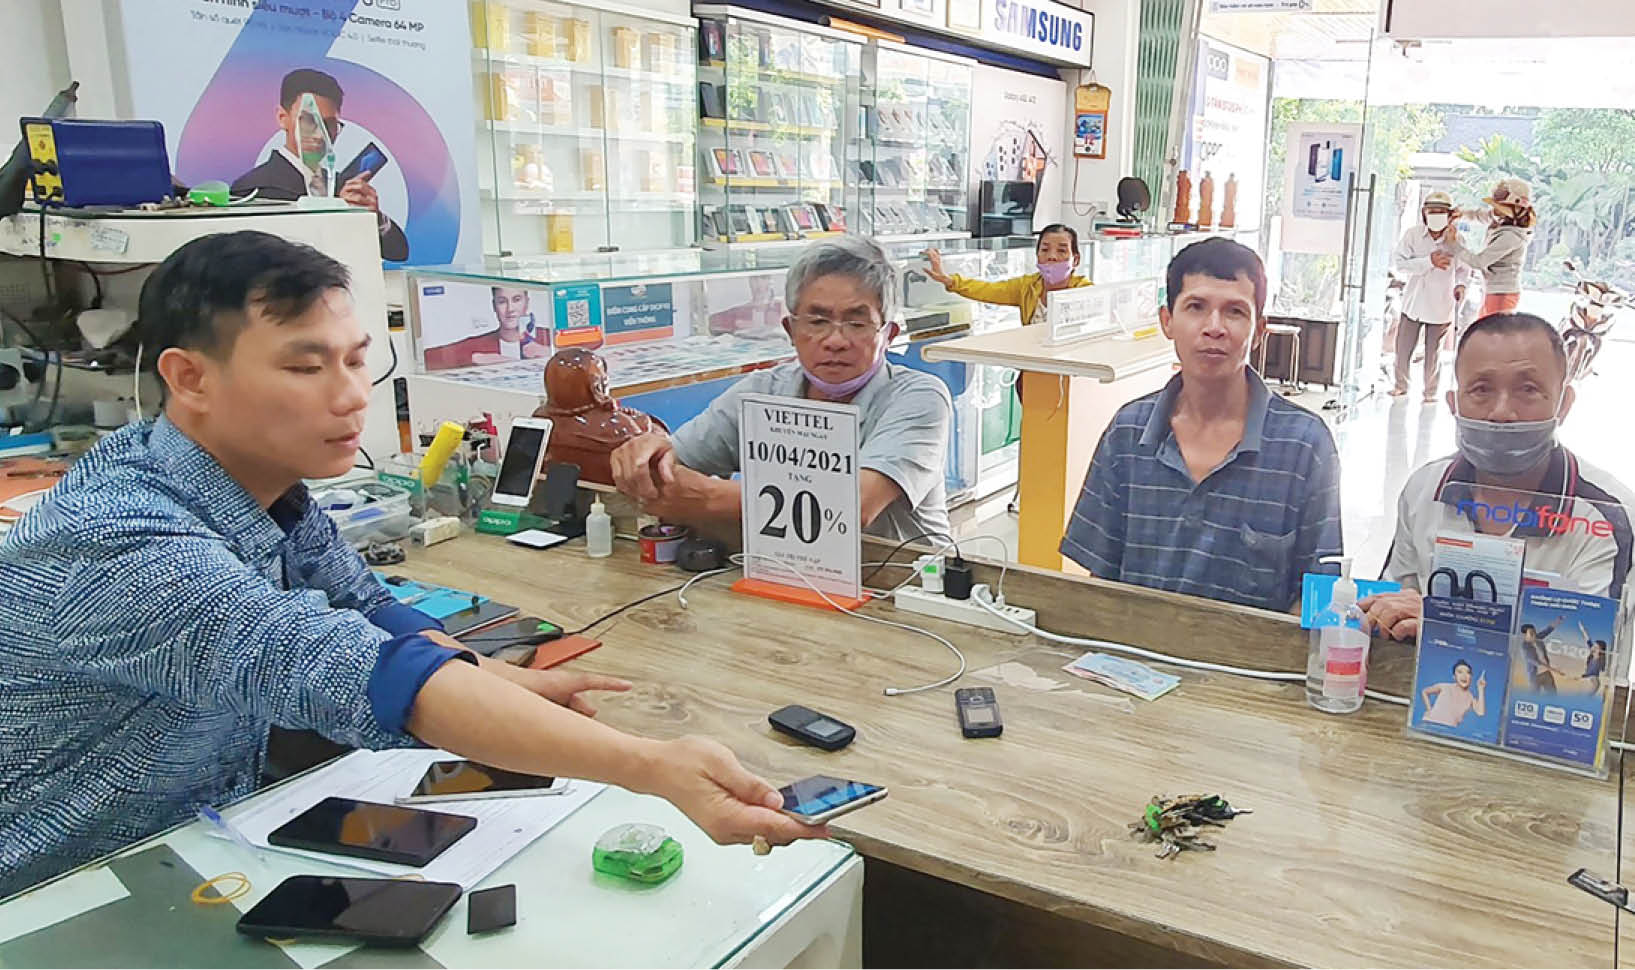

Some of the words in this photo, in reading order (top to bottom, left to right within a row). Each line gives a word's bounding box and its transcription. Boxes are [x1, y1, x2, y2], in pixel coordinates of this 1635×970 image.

[349, 12, 392, 29] Camera
[394, 19, 407, 31] 64
[408, 21, 425, 33] MP
[994, 0, 1082, 51] SAMSUNG
[763, 407, 834, 431] VIETTEL
[747, 440, 853, 475] 10/04/2021
[1456, 498, 1614, 538] mobifone
[1517, 703, 1534, 713] 120
